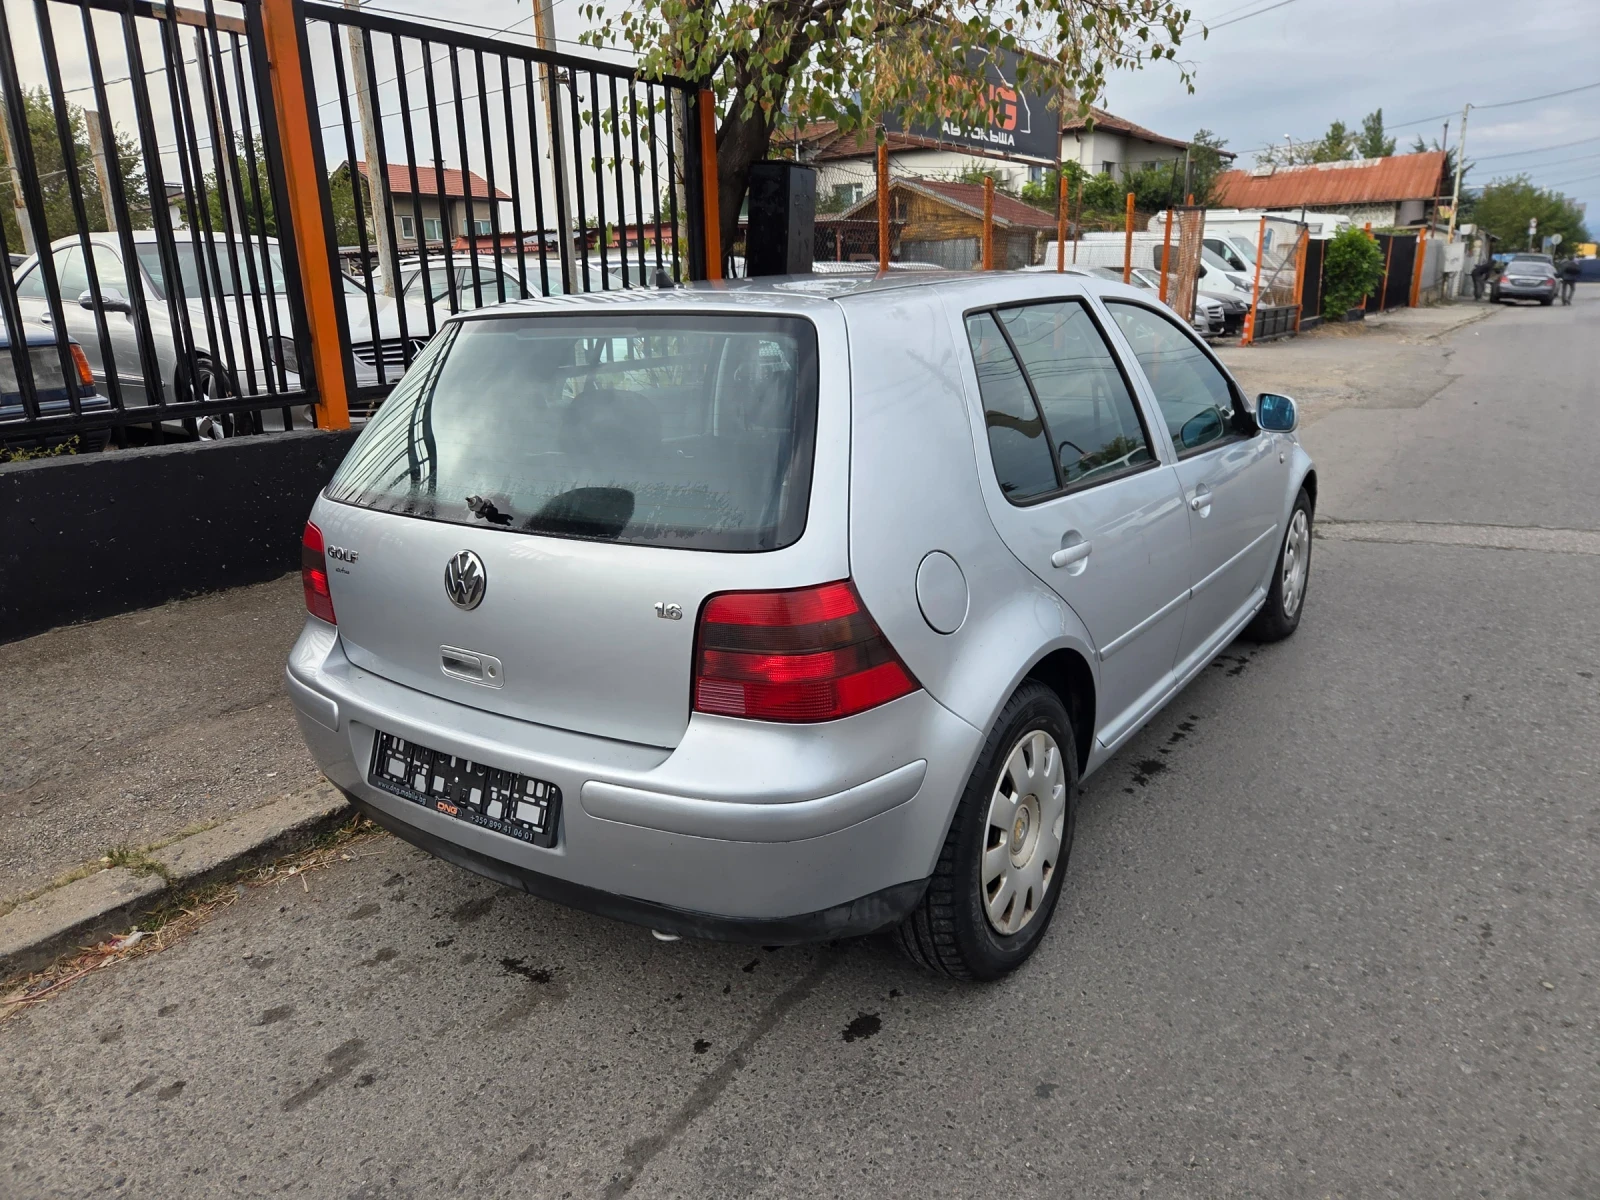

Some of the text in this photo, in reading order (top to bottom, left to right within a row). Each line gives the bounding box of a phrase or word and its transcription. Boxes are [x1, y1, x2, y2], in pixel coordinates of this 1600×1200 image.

[327, 544, 359, 564] GOLF
[377, 780, 427, 805] www.dng.mobile.bg
[437, 802, 458, 815] DNG
[470, 815, 533, 840] +359 899 41 06 01
